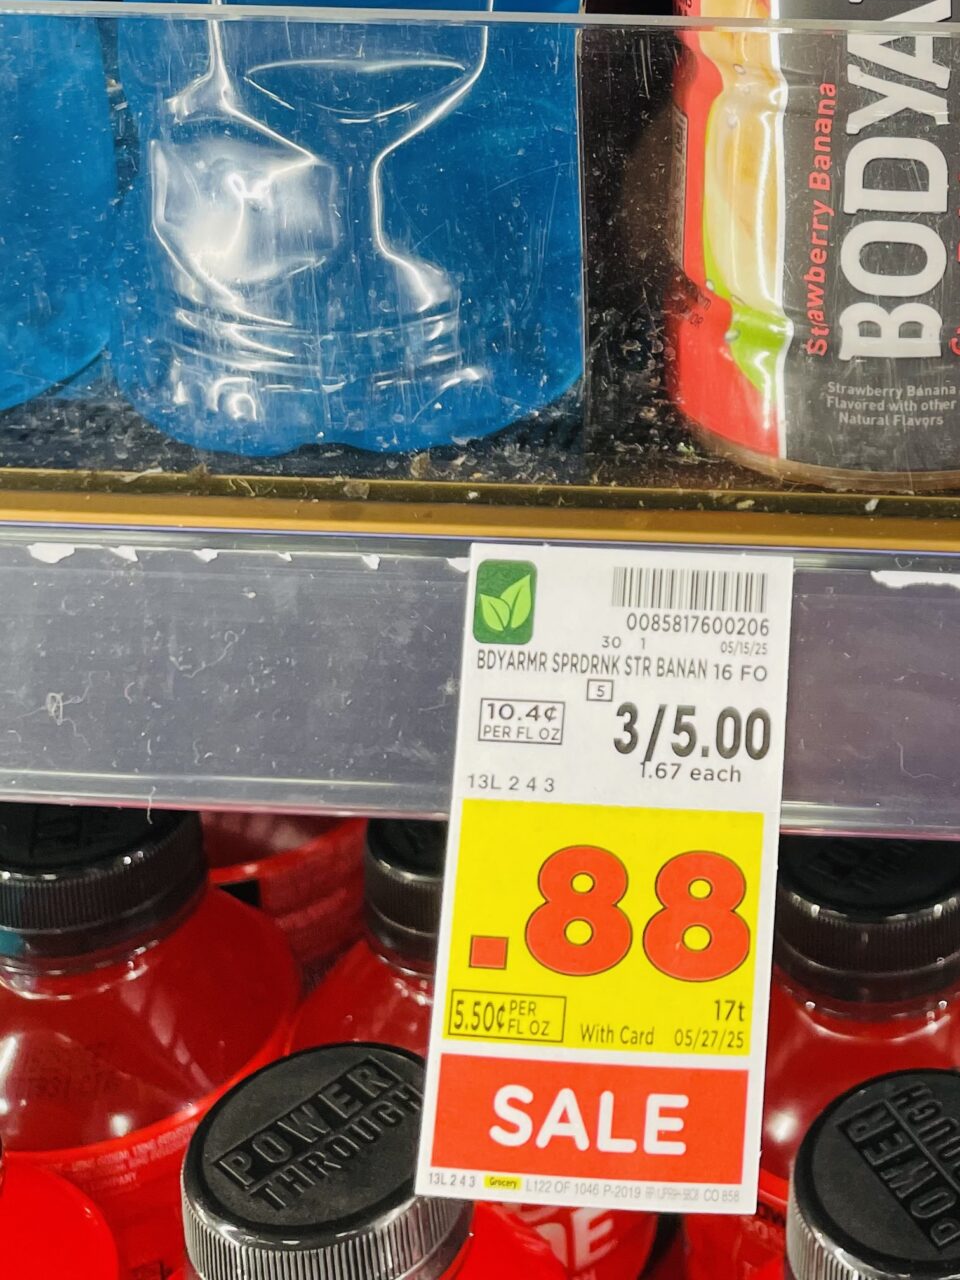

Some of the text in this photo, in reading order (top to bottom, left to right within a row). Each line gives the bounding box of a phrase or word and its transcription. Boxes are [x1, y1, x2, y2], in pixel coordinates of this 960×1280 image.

[805, 82, 837, 358] Strawberry Banana
[827, 381, 957, 400] Strawberry Banana
[826, 396, 958, 412] Flavored with other
[838, 411, 945, 427] Natural Flavors
[627, 612, 770, 637] 0085817600206
[601, 636, 622, 649] 30
[720, 640, 768, 655] 05/15/25
[477, 649, 768, 682] BDYARMR SPRDRNK STR BANAN 16 FO
[486, 702, 558, 722] 10.4¢
[483, 725, 561, 741] PER FL OZ
[613, 701, 771, 762] 3/5.00
[640, 760, 742, 783] 1.67 each
[468, 844, 751, 983] .88
[453, 998, 537, 1033] 5.50¢ PER
[713, 999, 746, 1022] 17t
[507, 1019, 550, 1036] FL OZ
[580, 1023, 655, 1046] With Card
[674, 1027, 745, 1050] 05/27/25
[218, 1067, 390, 1191] POWER
[489, 1084, 690, 1156] SALE
[250, 1083, 423, 1211] THROUGH
[489, 1177, 518, 1189] Grocery
[525, 1178, 551, 1194] L122
[554, 1181, 572, 1194] OF
[574, 1183, 599, 1196] 1046
